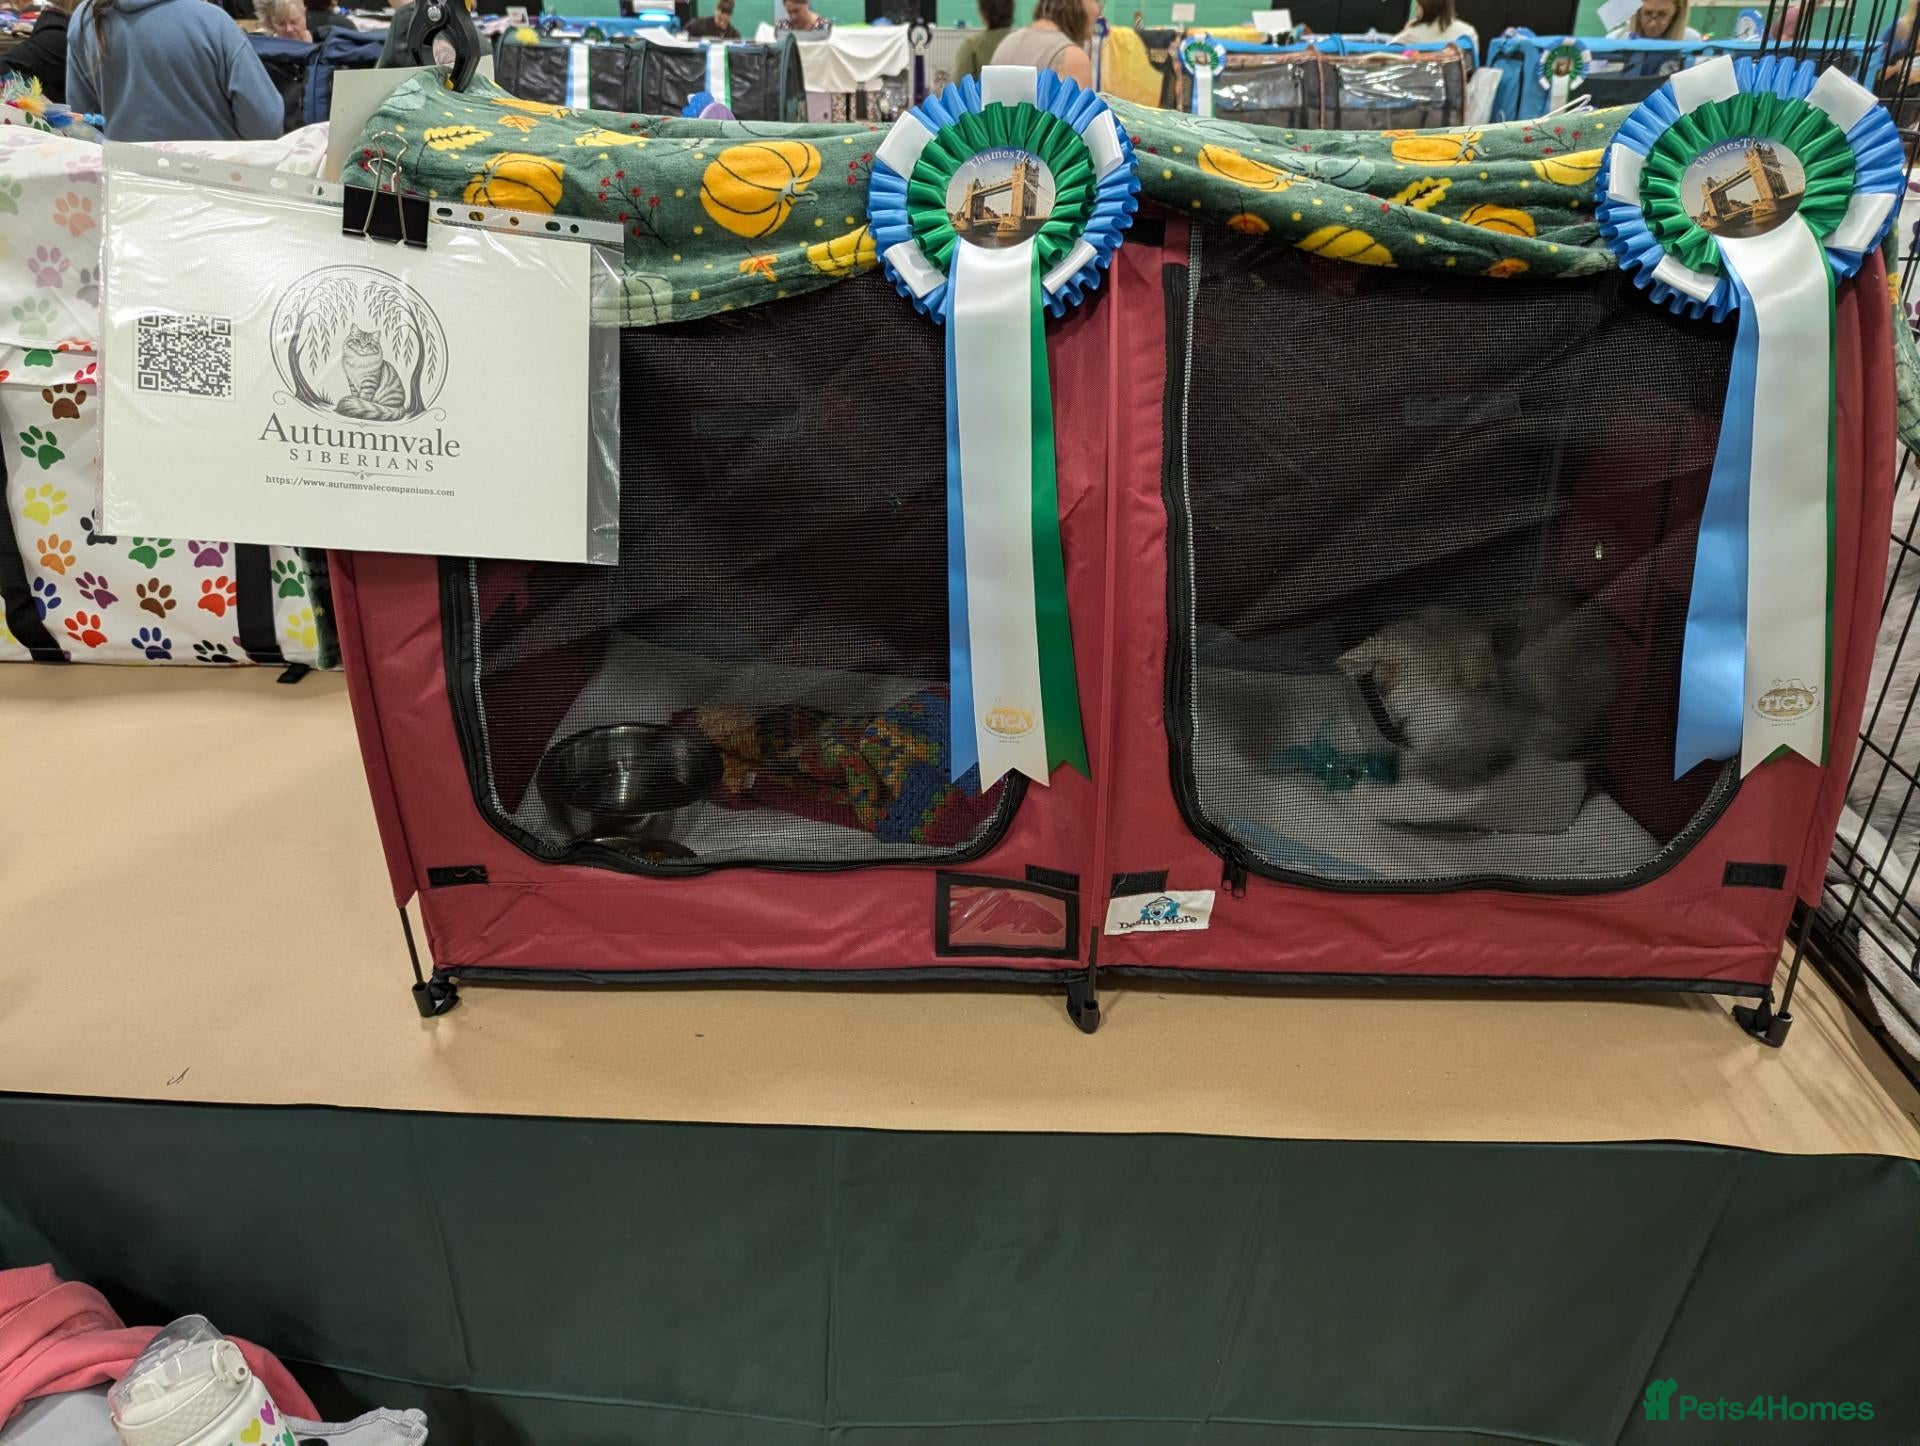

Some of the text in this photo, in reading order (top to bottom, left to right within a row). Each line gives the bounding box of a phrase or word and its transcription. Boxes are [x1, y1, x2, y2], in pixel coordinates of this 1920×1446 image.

[258, 412, 461, 457] Autumnvale
[289, 448, 434, 472] SIBERIANS
[265, 475, 455, 497] https://www.autumnvalecompanions.com
[1761, 693, 1809, 711] TICA
[1119, 915, 1198, 929] Desire More
